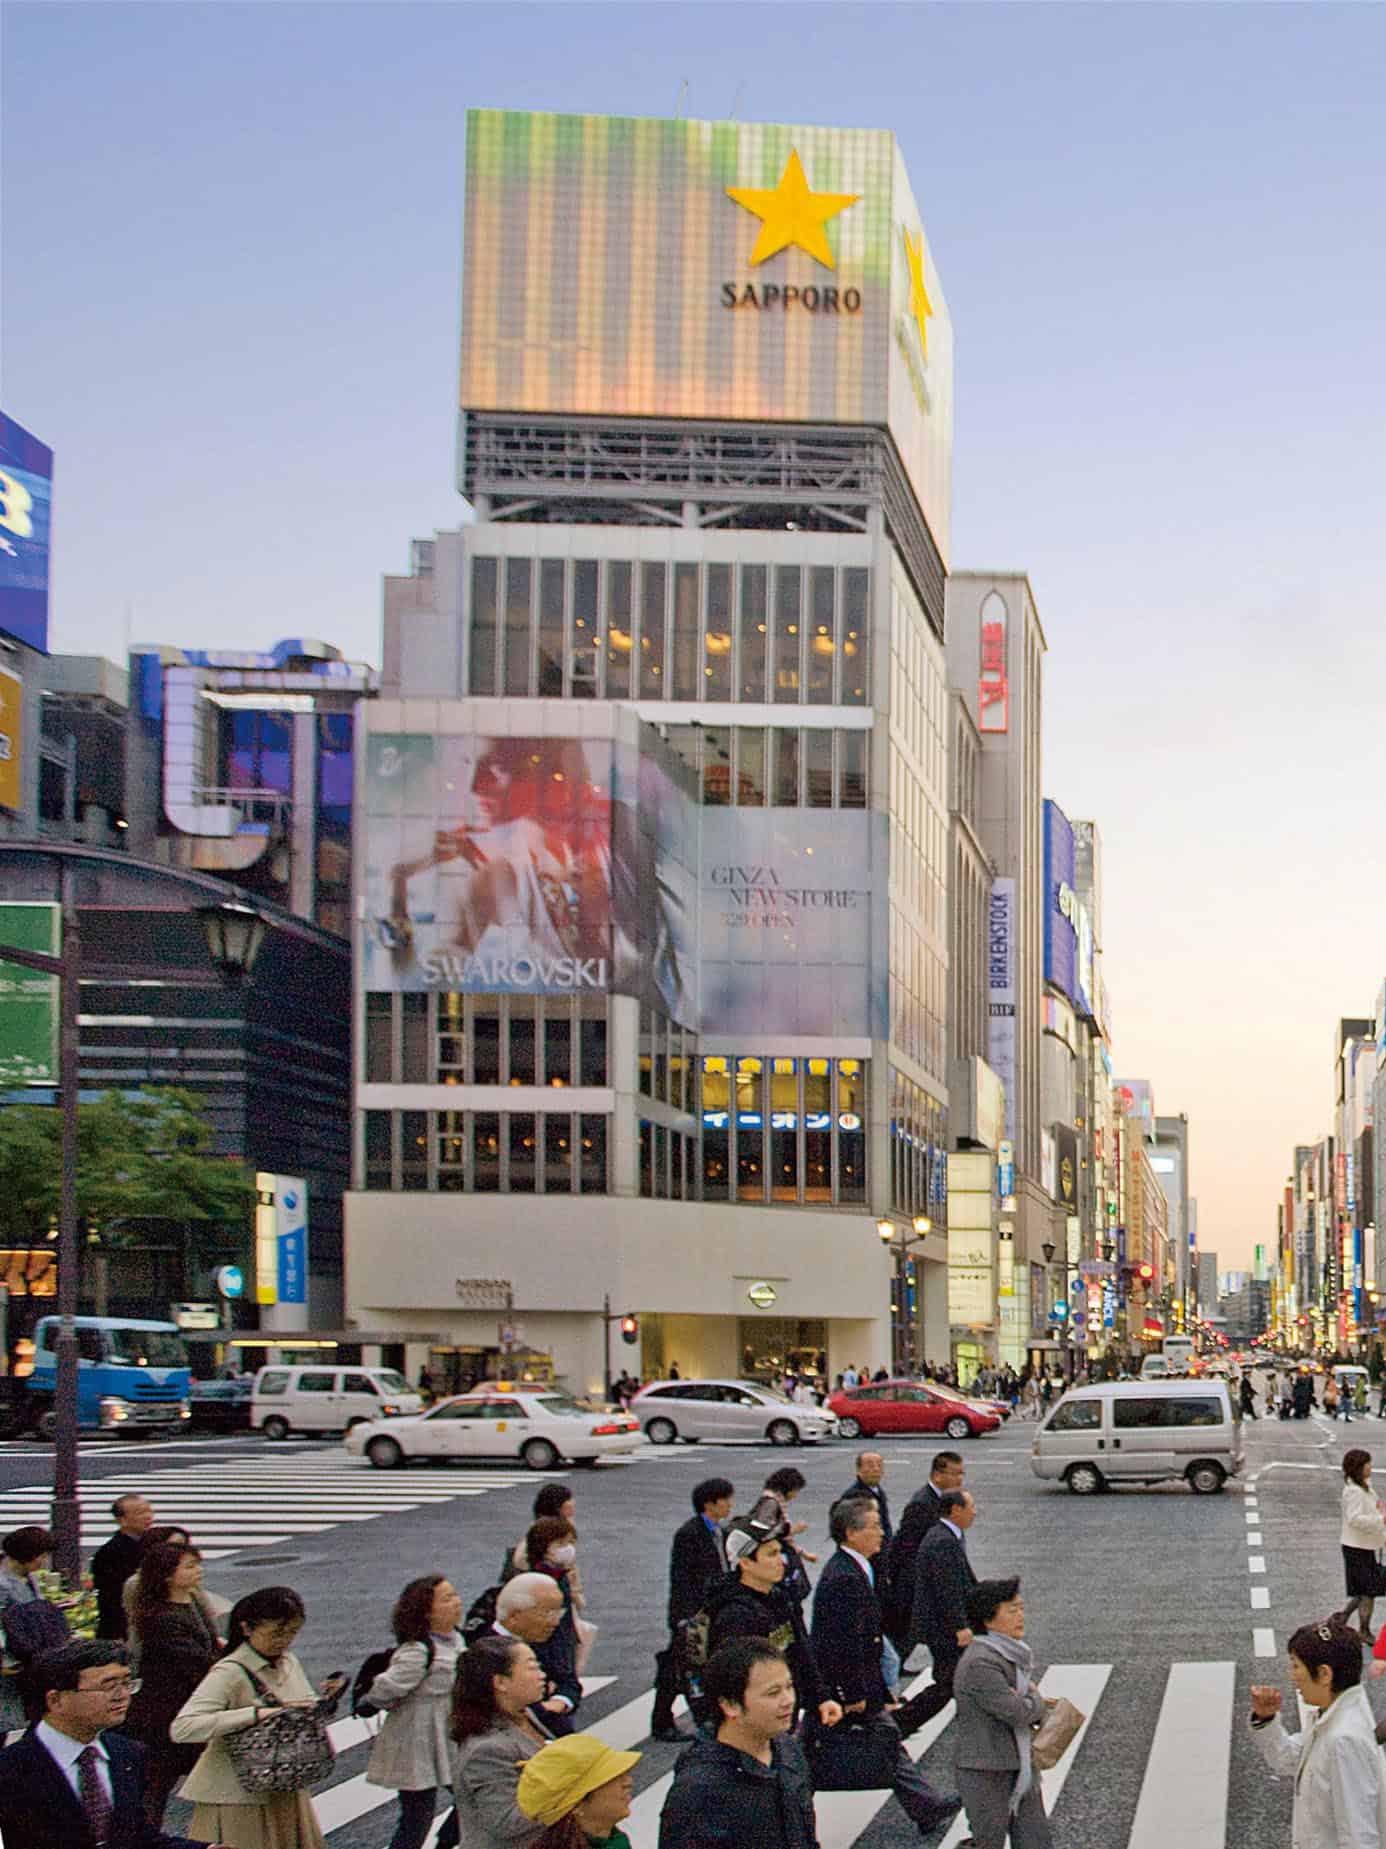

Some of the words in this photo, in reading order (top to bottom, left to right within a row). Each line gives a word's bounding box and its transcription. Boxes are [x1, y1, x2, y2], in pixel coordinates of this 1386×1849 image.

[720, 282, 862, 313] SAPPORO
[711, 867, 780, 885] GINZA
[729, 887, 777, 905] NEW
[784, 889, 857, 908] STORE
[990, 893, 1008, 989] BIRKENSTOCK
[420, 956, 608, 989] SWAROVSKI
[703, 1111, 831, 1130] イーオン
